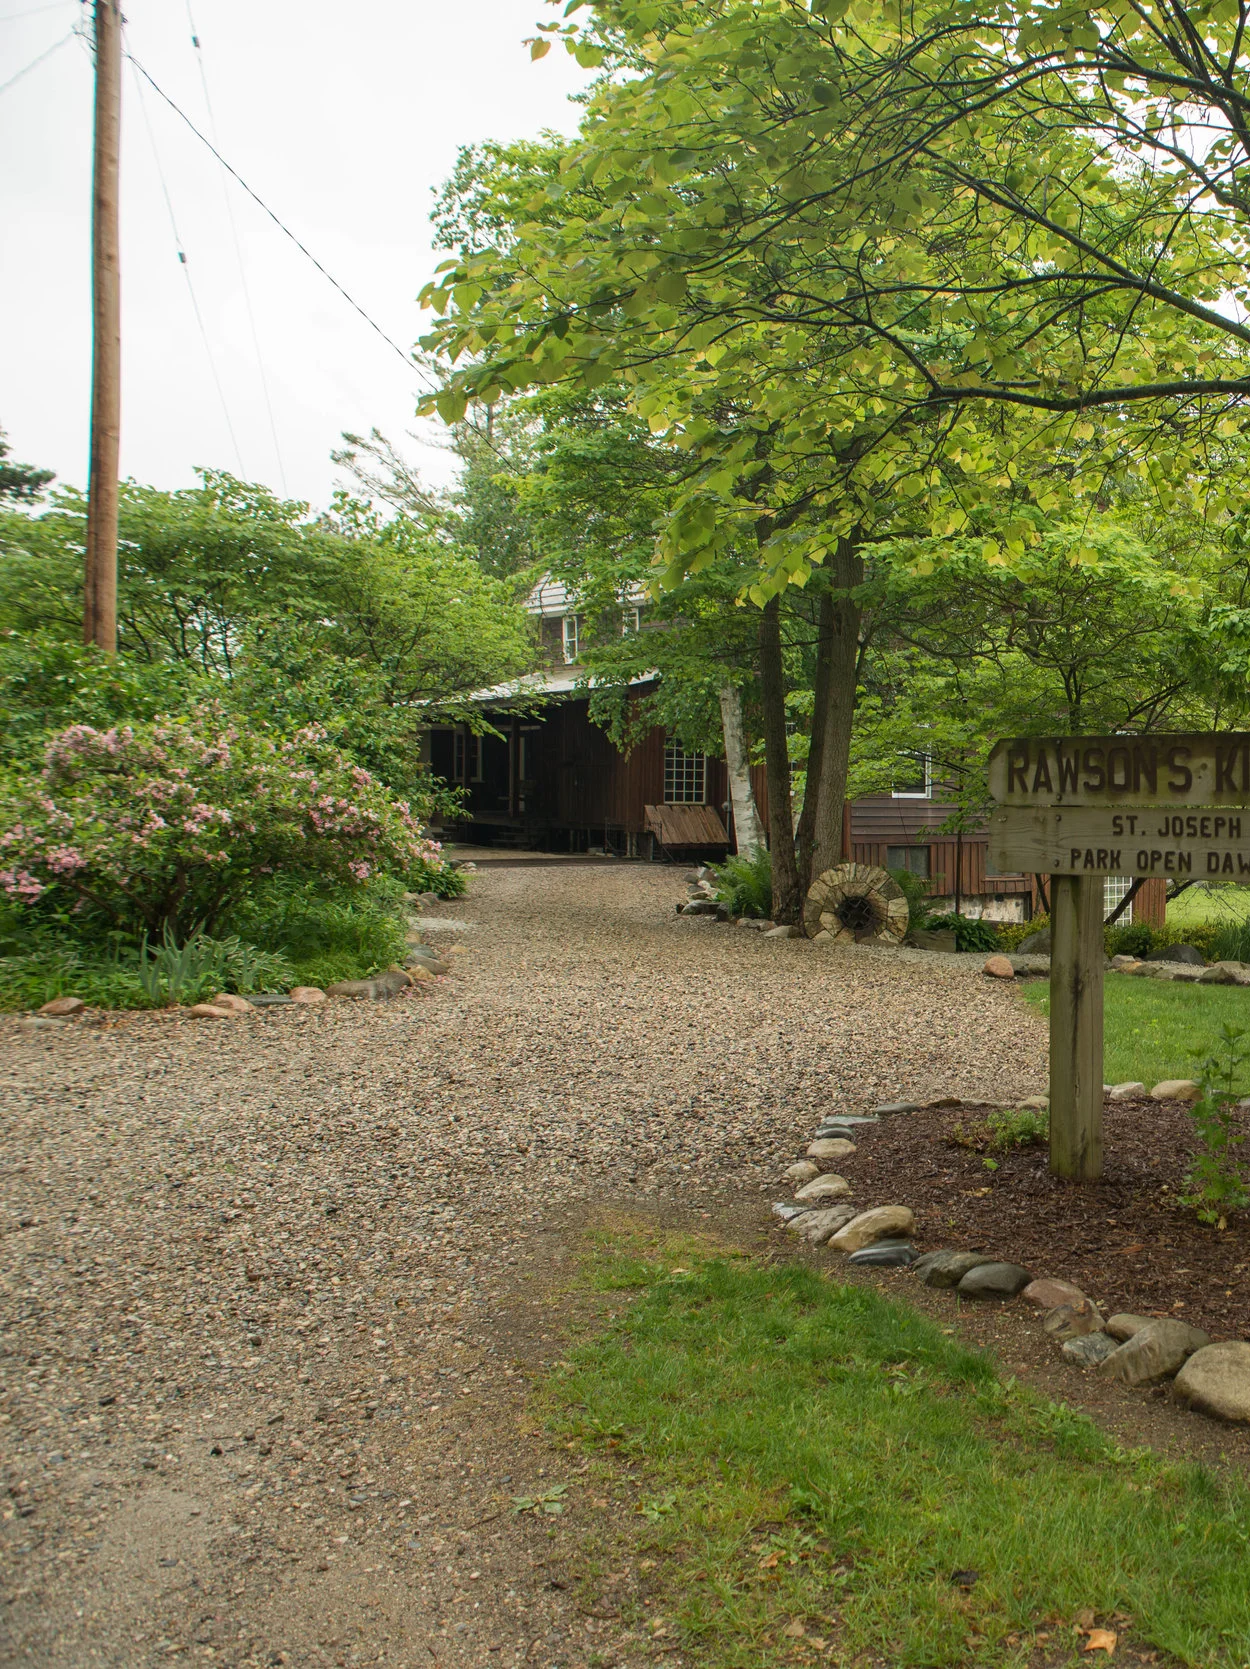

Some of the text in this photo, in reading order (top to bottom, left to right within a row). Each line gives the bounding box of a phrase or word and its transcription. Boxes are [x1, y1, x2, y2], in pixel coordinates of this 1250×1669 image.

[1112, 815, 1147, 837] ST.
[1157, 816, 1242, 840] JOSEPH
[1070, 848, 1122, 870] PARK
[1136, 850, 1193, 873] OPEN
